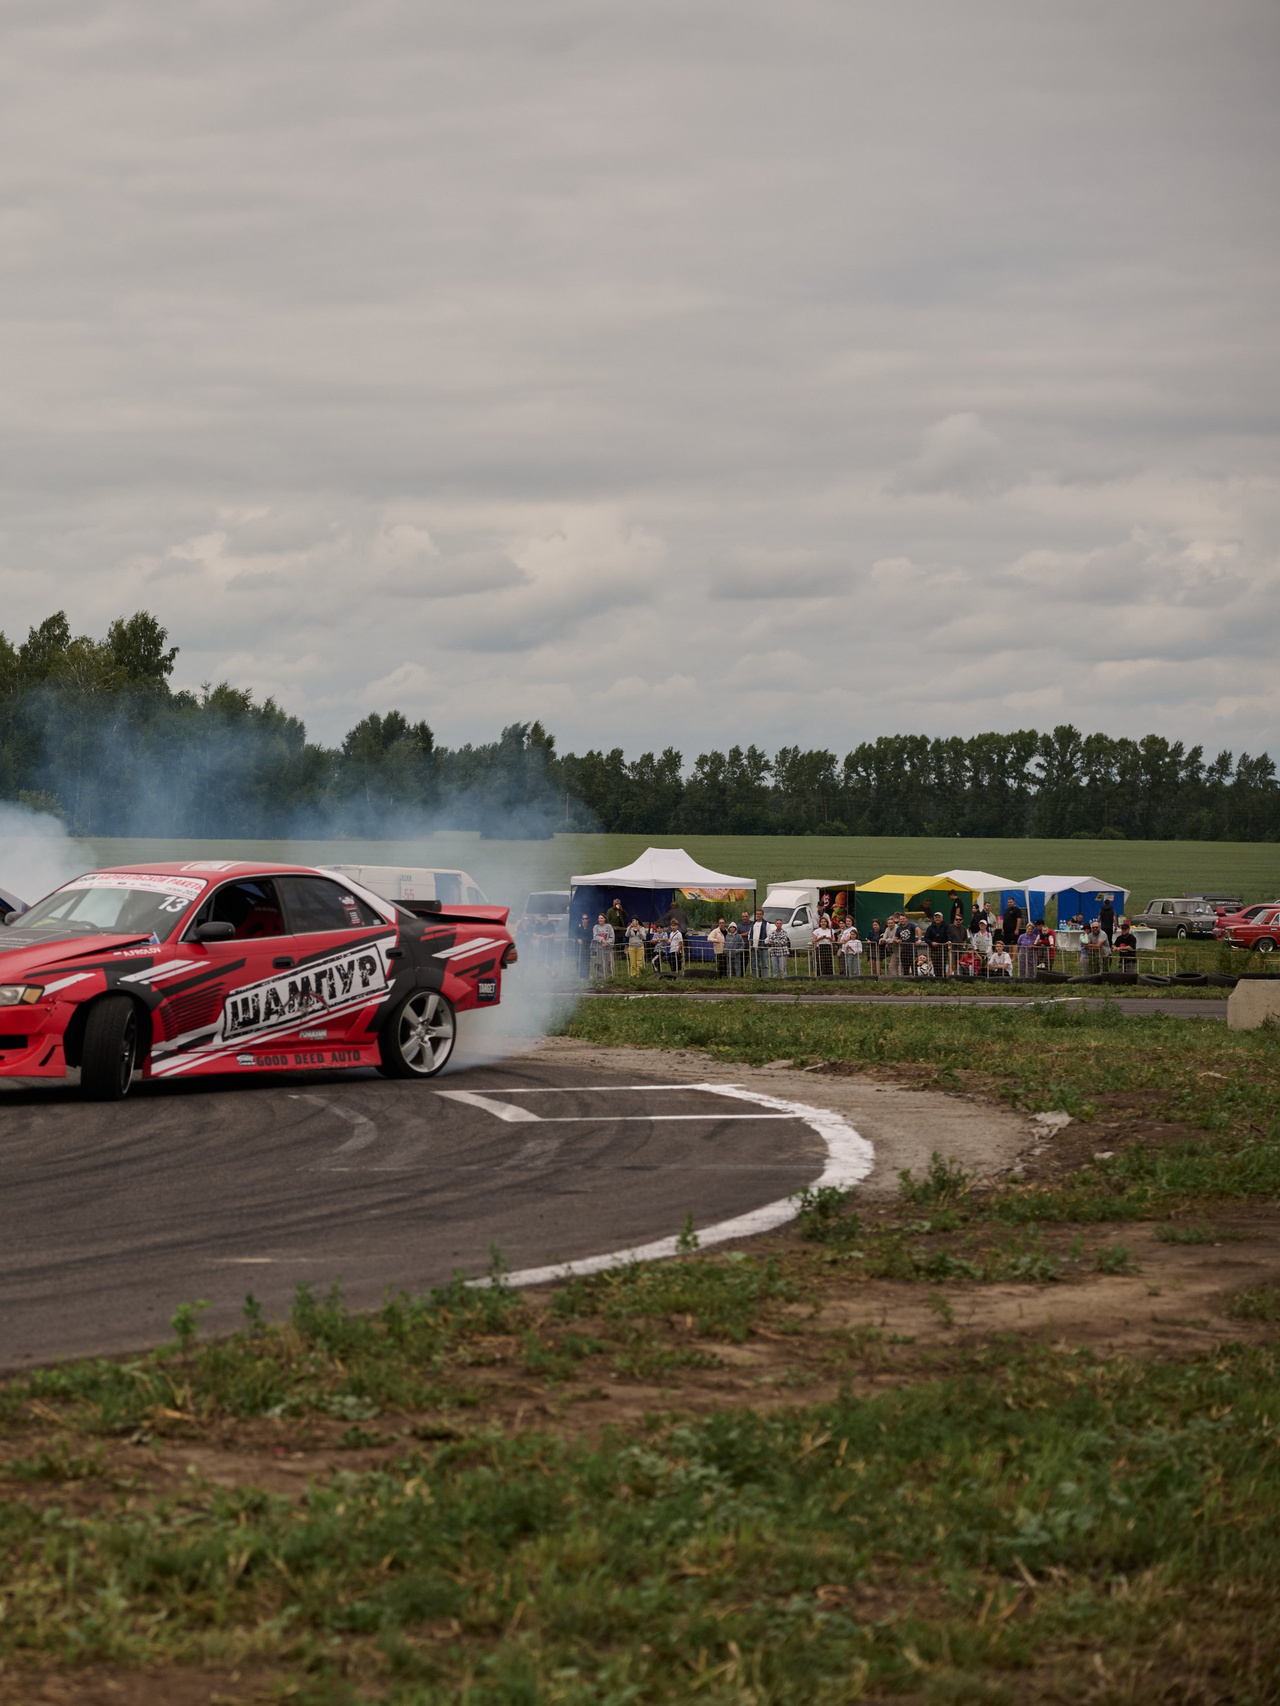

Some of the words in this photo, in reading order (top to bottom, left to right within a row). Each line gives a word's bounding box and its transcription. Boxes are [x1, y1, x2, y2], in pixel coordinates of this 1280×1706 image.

[158, 895, 189, 912] 13
[231, 955, 377, 1031] ШАМПУР
[478, 983, 496, 994] TARGET
[257, 1055, 288, 1067] GOOD
[294, 1053, 324, 1065] DEED
[331, 1051, 360, 1063] AUTO
